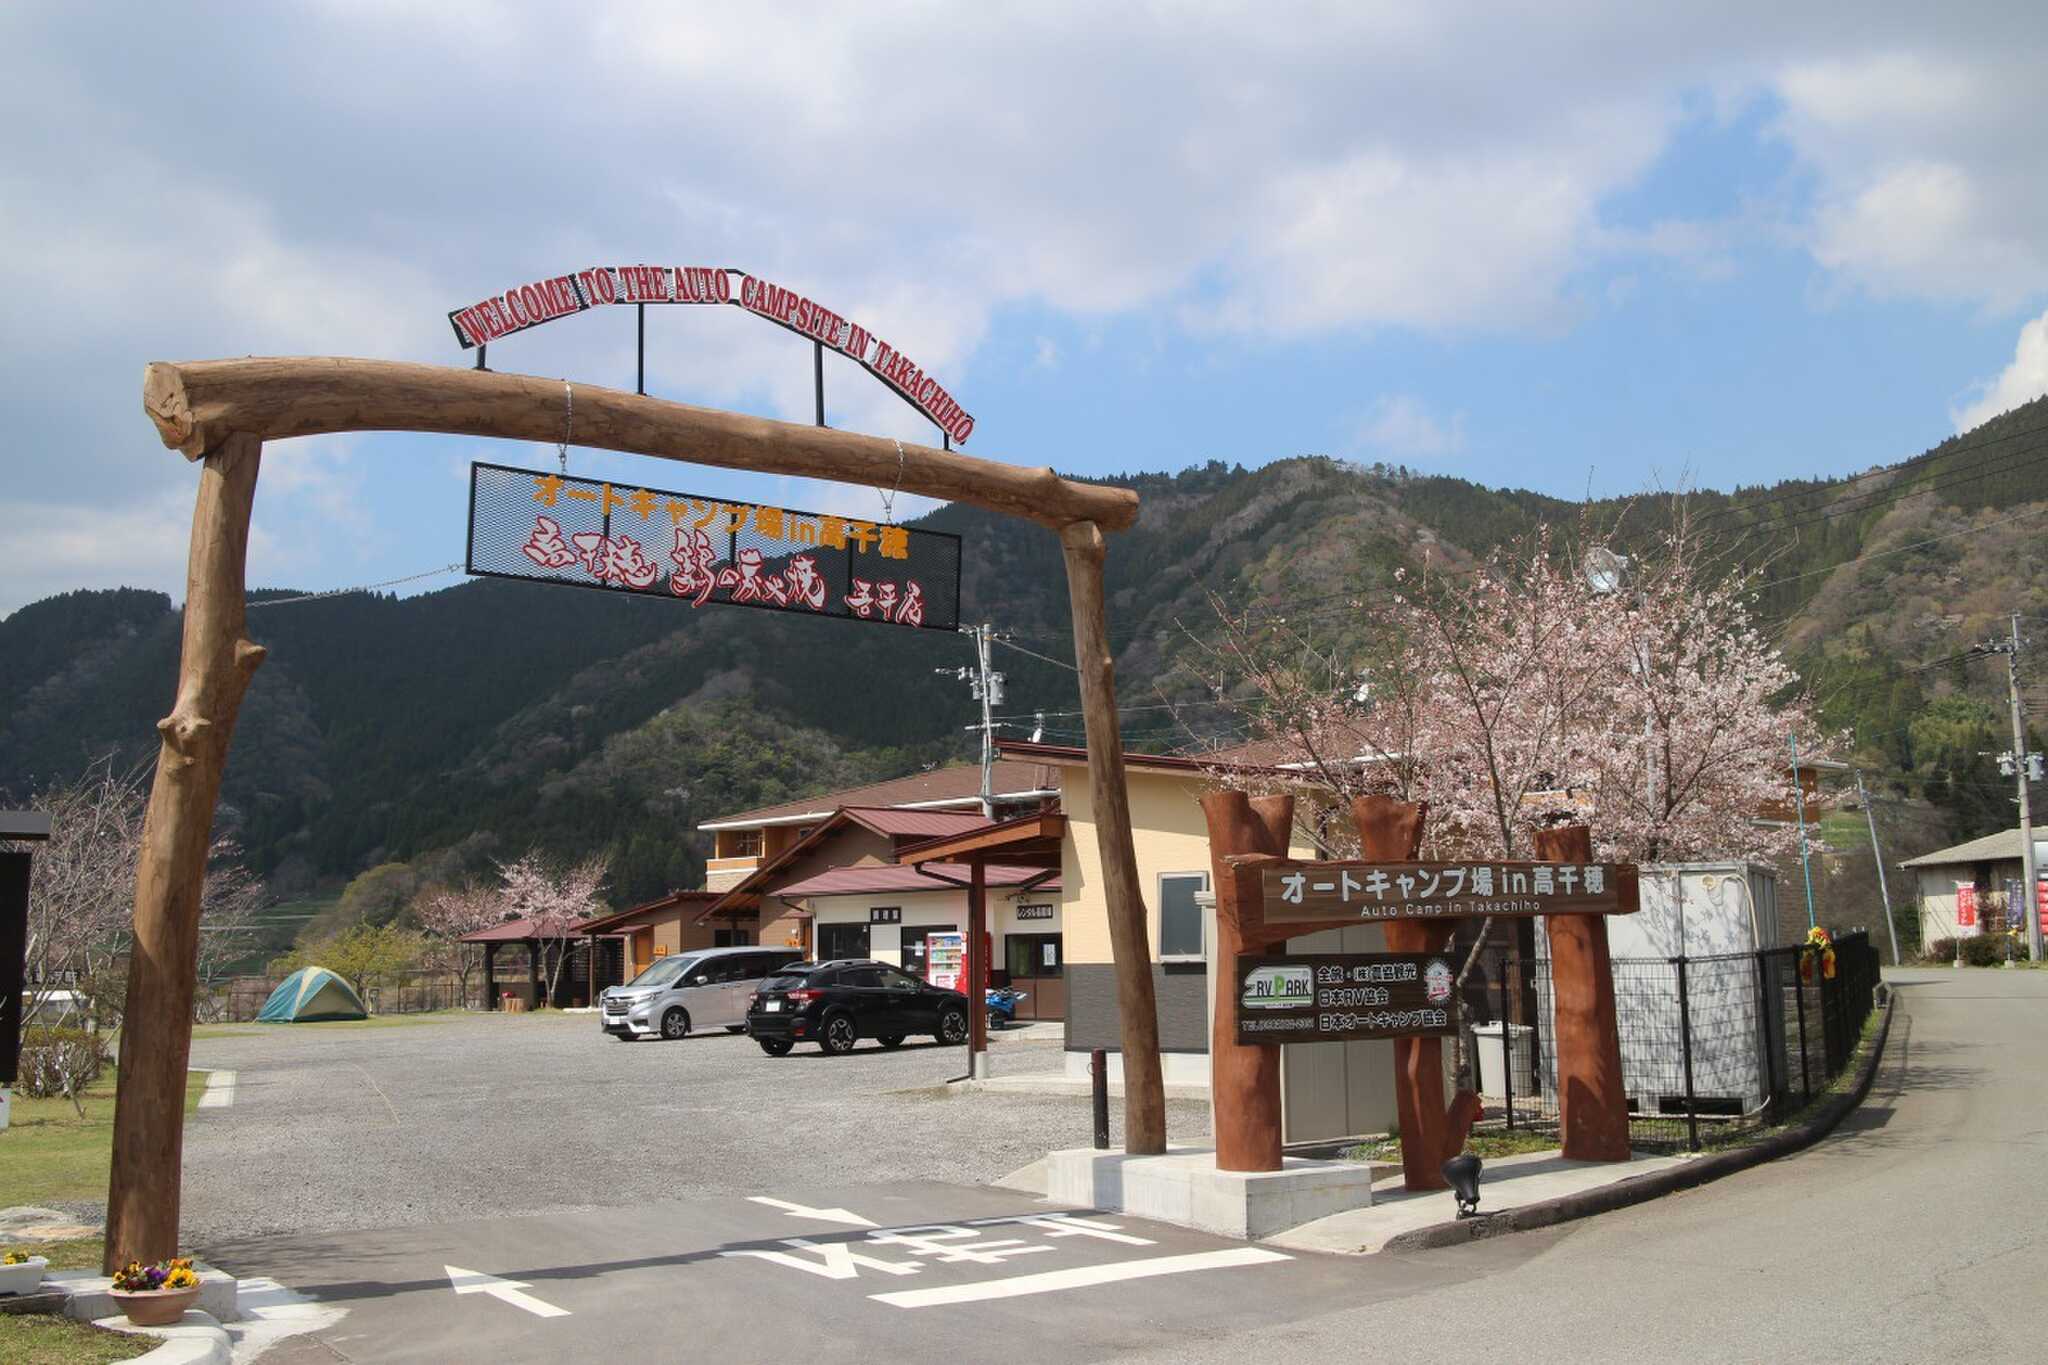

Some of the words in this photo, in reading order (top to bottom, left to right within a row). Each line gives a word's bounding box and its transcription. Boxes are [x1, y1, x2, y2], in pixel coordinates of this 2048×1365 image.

[454, 275, 579, 346] WELCOME
[578, 267, 616, 304] TO
[619, 266, 668, 302] THE
[674, 267, 731, 302] AUTO
[739, 274, 844, 346] CAMPSITE
[844, 322, 872, 361] IN
[870, 339, 974, 443] TAKACHIHO
[1360, 904, 1398, 917] Auto
[1405, 903, 1442, 916] Camp
[1448, 901, 1462, 913] in
[1470, 899, 1541, 912] Takachiho
[1256, 980, 1273, 998] RV
[1274, 975, 1309, 1002] PARK
